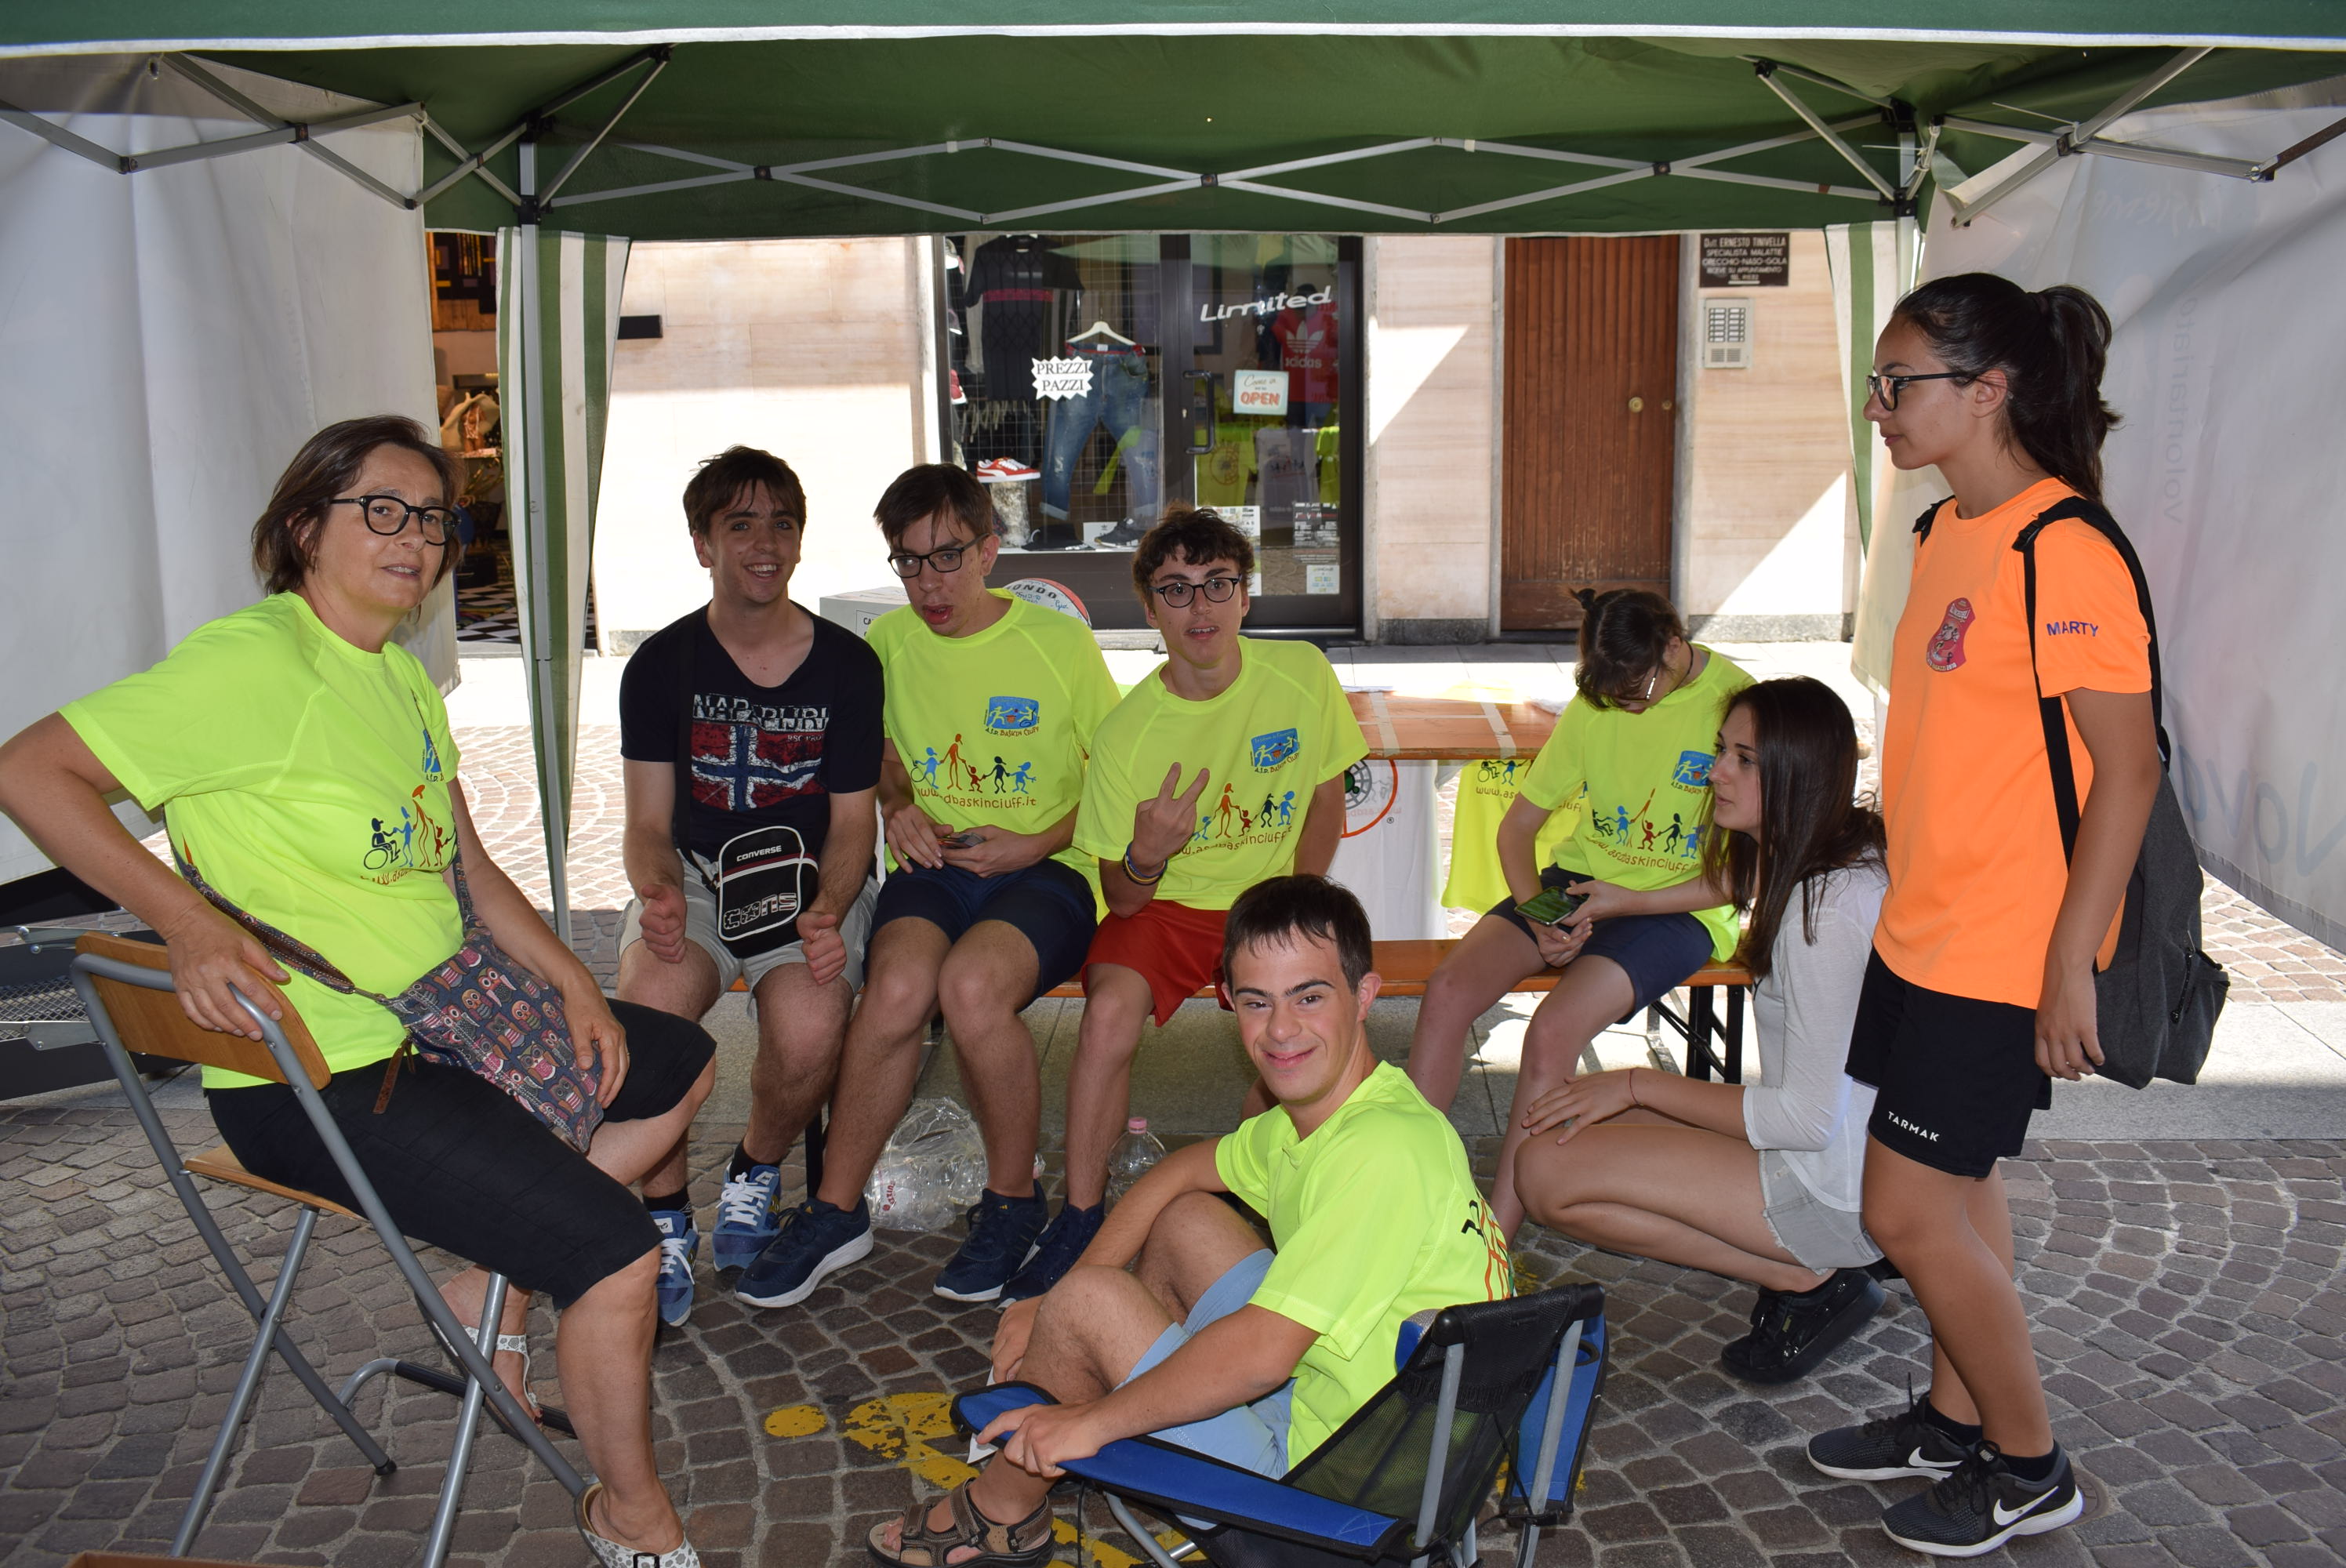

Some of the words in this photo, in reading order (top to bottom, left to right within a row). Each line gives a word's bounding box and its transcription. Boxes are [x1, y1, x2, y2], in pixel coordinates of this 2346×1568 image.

[1200, 285, 1331, 321] Limited
[1037, 362, 1090, 375] PREZZI
[1042, 379, 1085, 391] PAZZI
[1240, 391, 1280, 405] OPEN
[1006, 583, 1057, 600] ONDO
[2046, 621, 2099, 637] MARTY
[736, 844, 783, 862] CONVERSE
[1888, 1111, 1941, 1142] TARMAK
